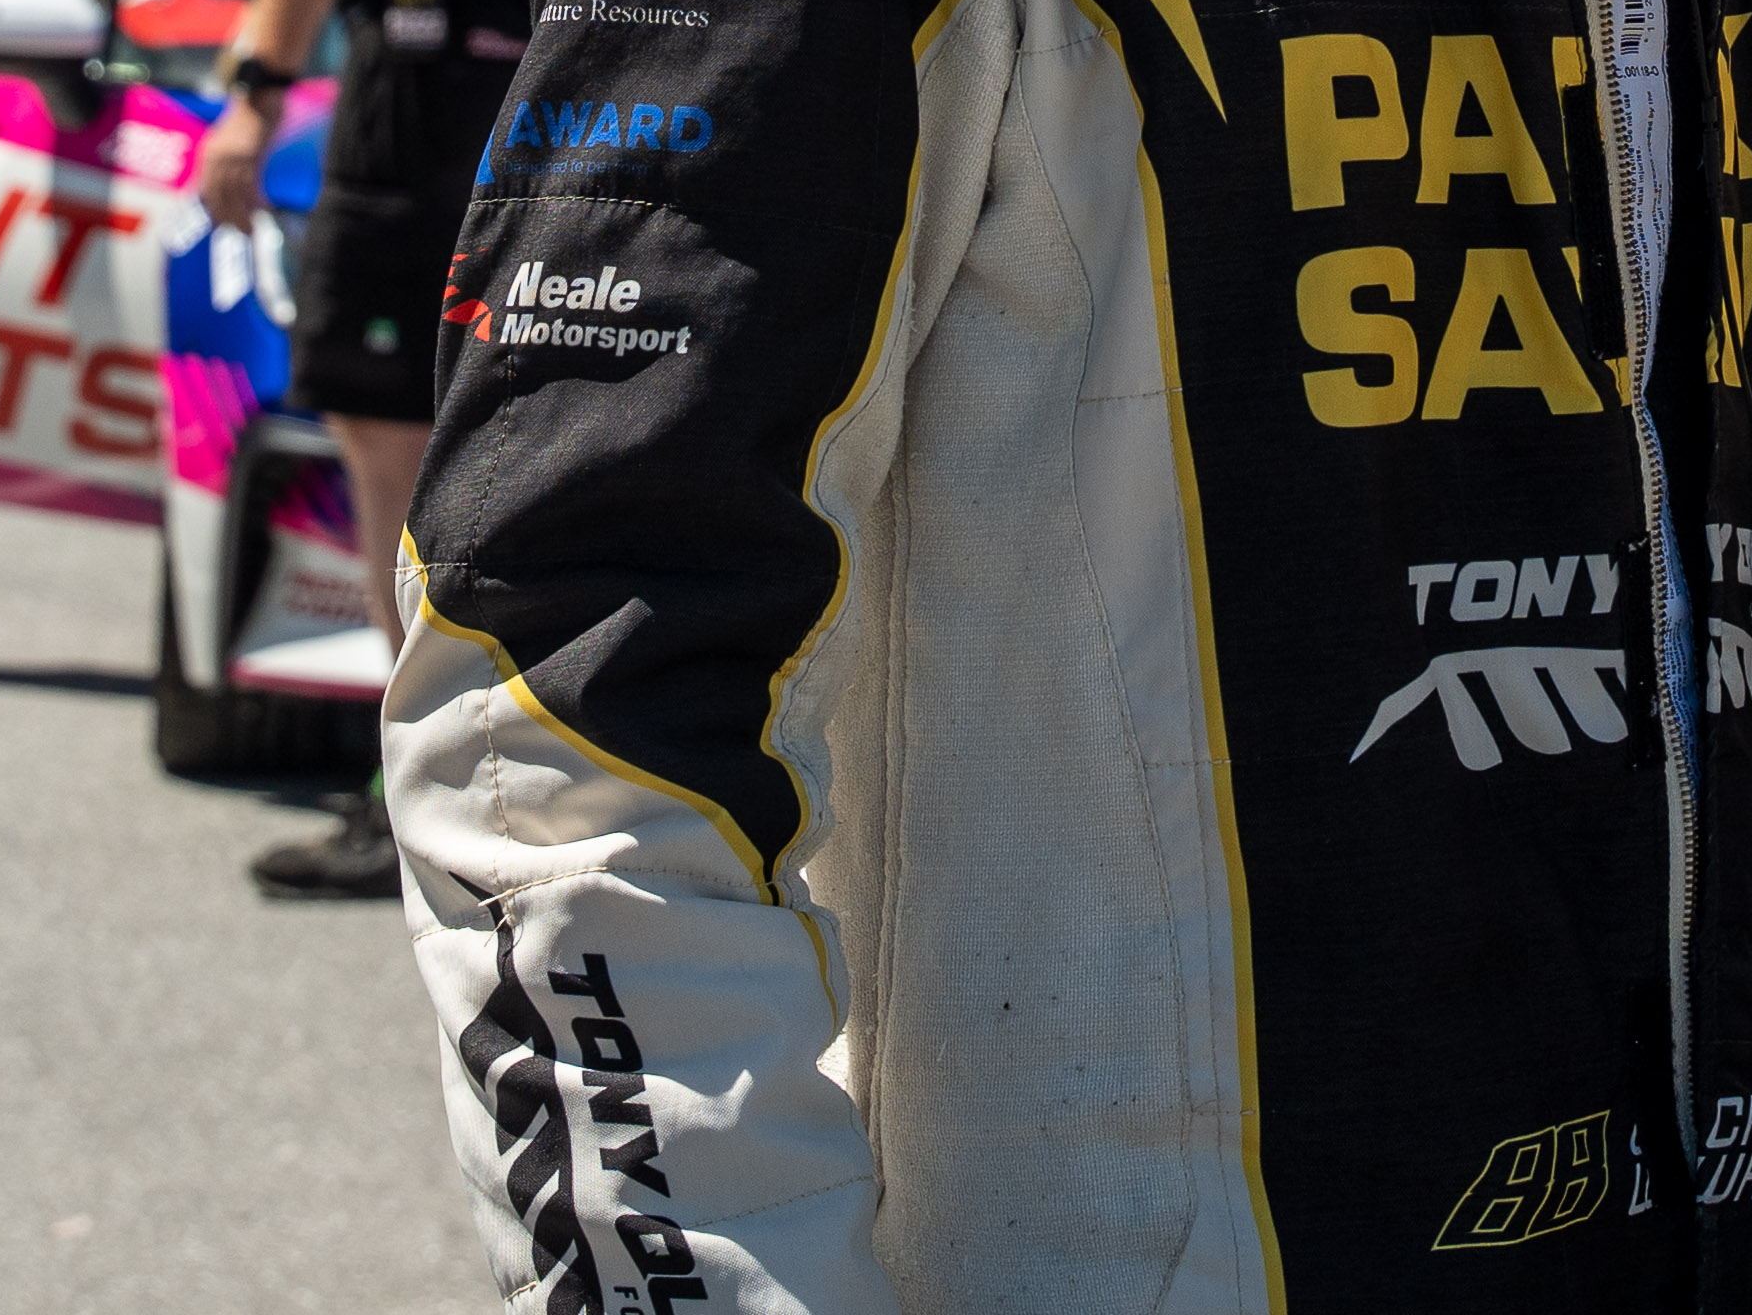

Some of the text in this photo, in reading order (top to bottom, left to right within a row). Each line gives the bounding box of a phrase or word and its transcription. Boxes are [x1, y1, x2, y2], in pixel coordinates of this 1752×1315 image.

[505, 100, 714, 153] AWARD
[505, 259, 641, 314] Neale
[499, 313, 691, 358] Motorsport
[547, 953, 671, 1200] TONY
